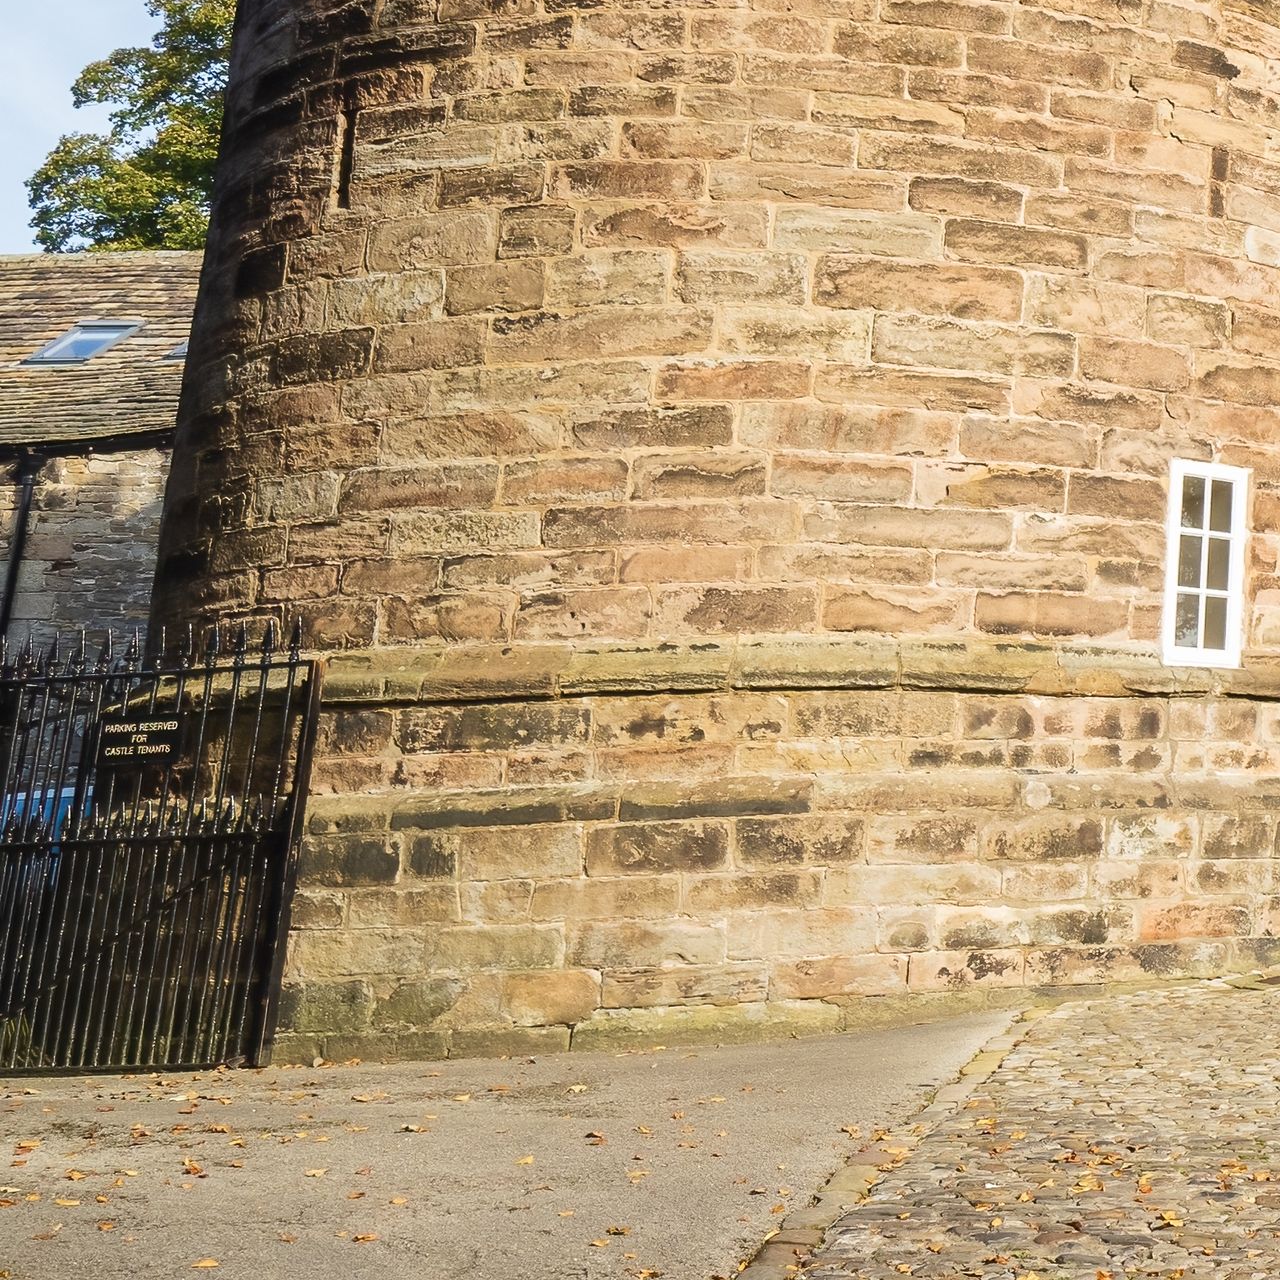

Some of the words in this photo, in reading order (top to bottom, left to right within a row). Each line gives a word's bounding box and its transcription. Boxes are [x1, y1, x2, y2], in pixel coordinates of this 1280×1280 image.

[105, 723, 137, 733] PARKING
[139, 721, 178, 731] RESERVED
[131, 734, 148, 743] FOR
[105, 746, 134, 756] CASTLE
[137, 744, 171, 754] TENANTS
